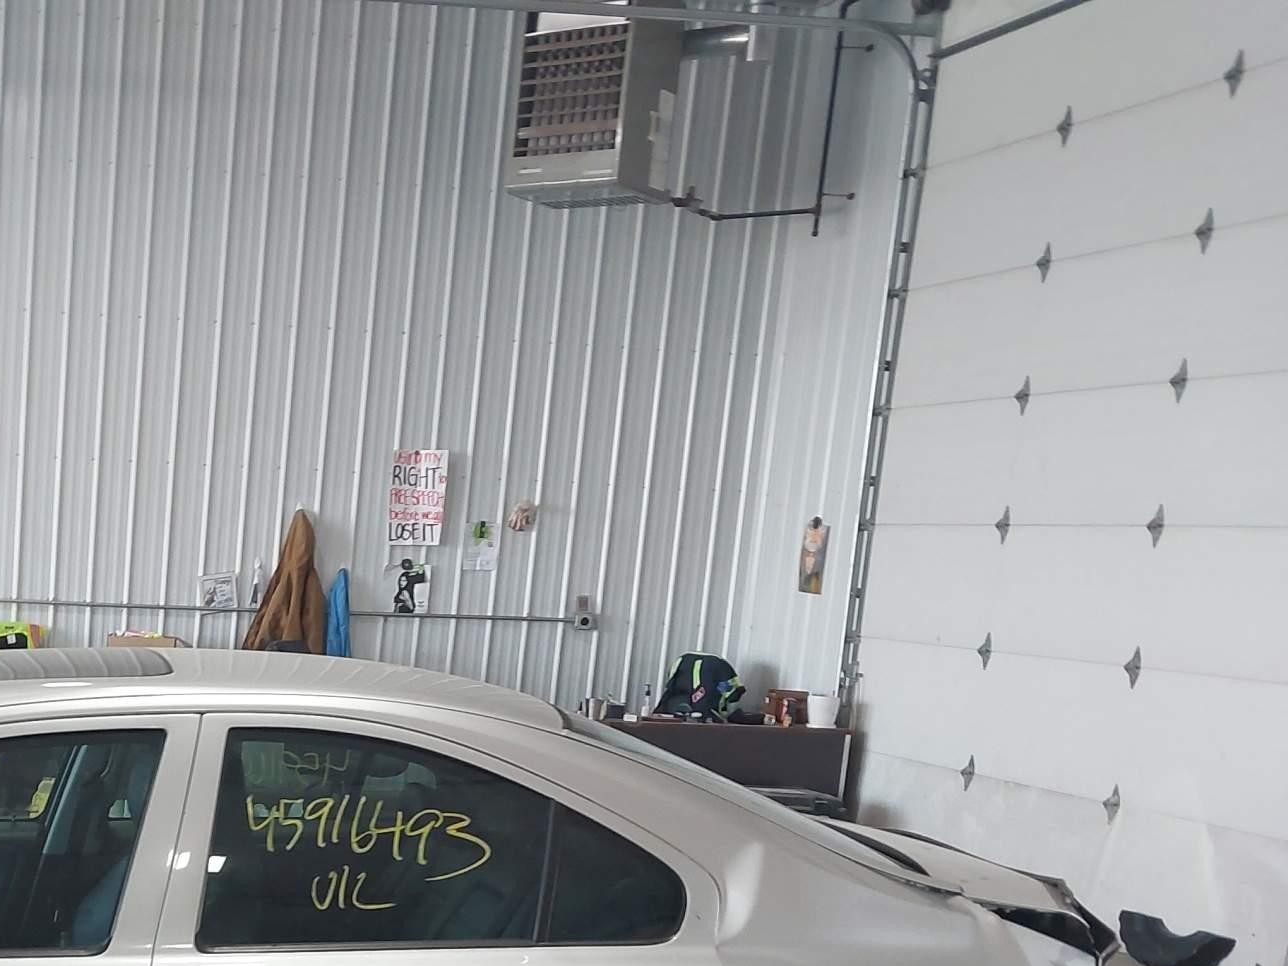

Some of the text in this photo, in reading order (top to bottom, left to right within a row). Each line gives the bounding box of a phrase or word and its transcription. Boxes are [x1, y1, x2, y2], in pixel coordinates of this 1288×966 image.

[392, 465, 442, 489] RIGHT
[389, 488, 412, 505] FREE
[388, 521, 439, 542] LOSE IT
[246, 794, 492, 882] 45916493
